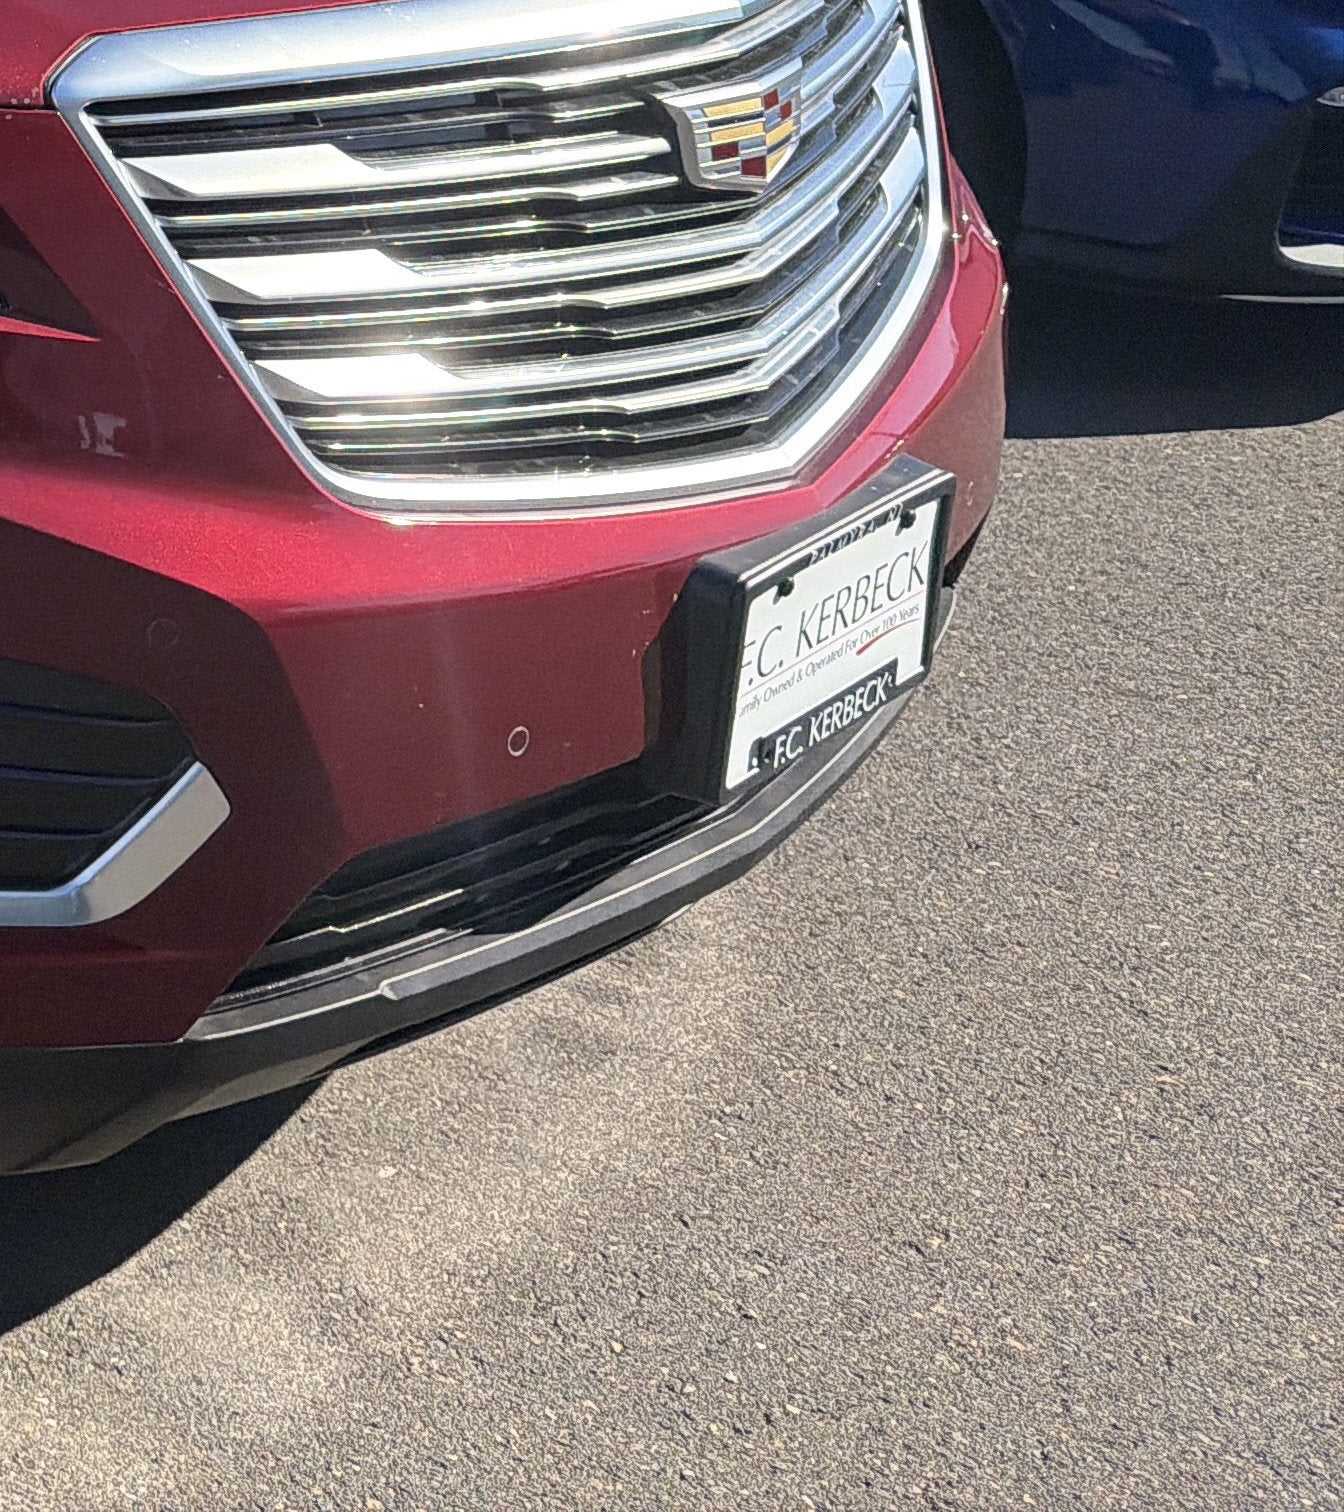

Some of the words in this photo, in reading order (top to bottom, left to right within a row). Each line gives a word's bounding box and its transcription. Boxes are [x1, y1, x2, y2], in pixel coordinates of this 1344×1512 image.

[796, 541, 929, 657] KERBECK
[739, 695, 762, 718] amily
[763, 669, 795, 702] Owned
[805, 642, 845, 676] Operated
[844, 637, 859, 653] For
[860, 625, 881, 644] Over
[882, 615, 897, 631] 100
[899, 603, 921, 623] Years
[809, 672, 890, 747] KERBECK
